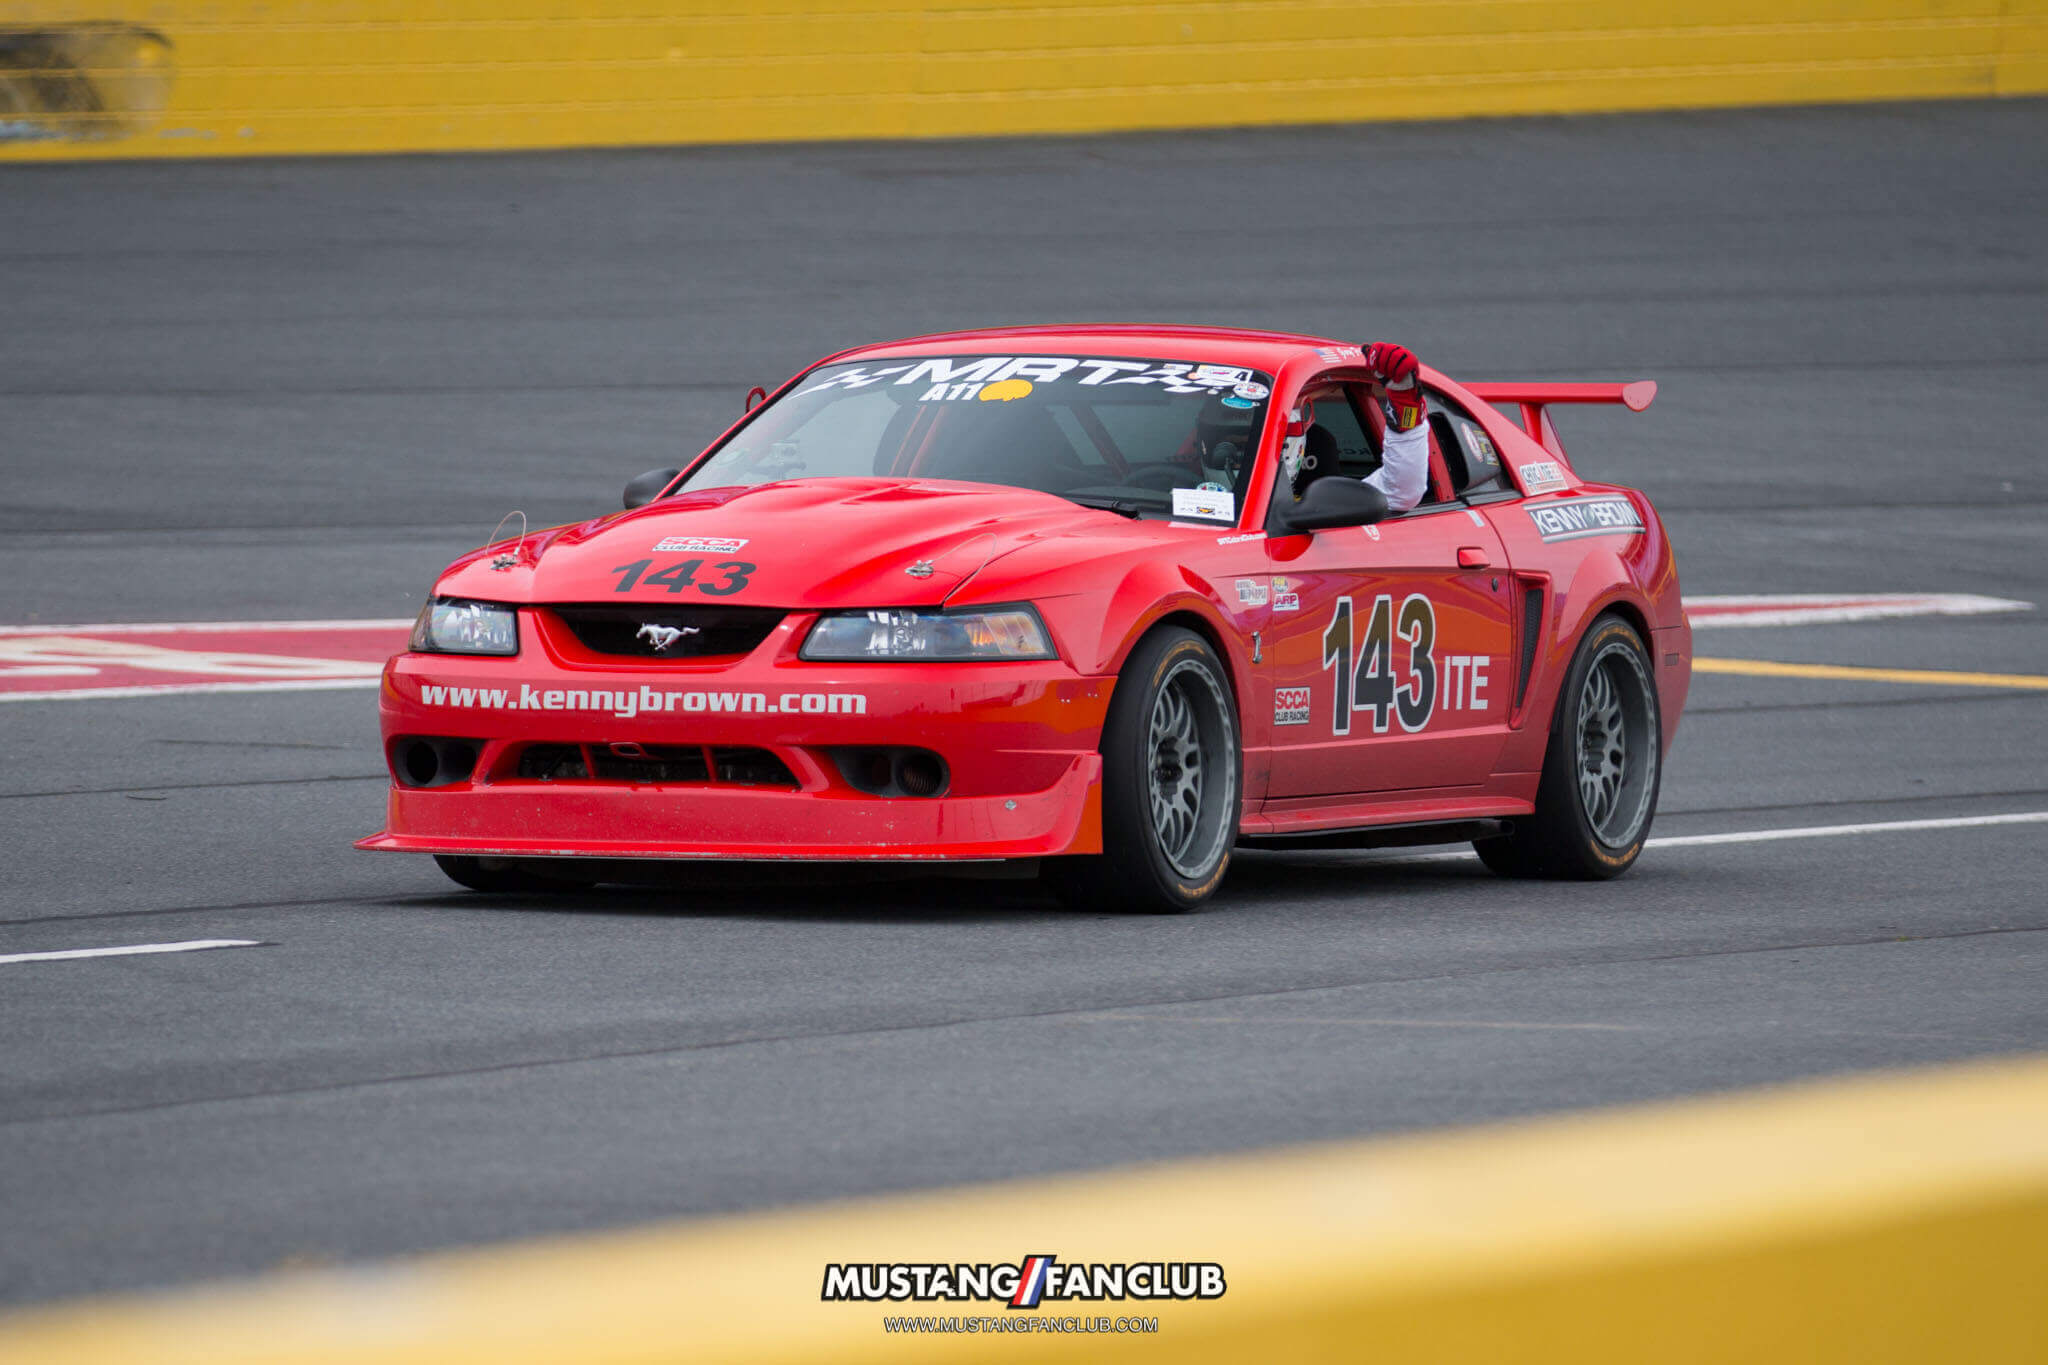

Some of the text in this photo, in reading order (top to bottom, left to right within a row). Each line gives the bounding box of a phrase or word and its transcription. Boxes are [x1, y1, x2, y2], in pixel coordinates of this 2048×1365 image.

[1530, 502, 1642, 534] KENNY BROWN
[662, 537, 742, 547] SCCA
[611, 560, 757, 596] 143
[1275, 595, 1297, 605] ARP
[1322, 593, 1490, 736] 143 ITE
[421, 685, 867, 717] www.kennybrown.com
[1276, 690, 1308, 709] SCCA
[1275, 710, 1309, 722] CLUB RACING
